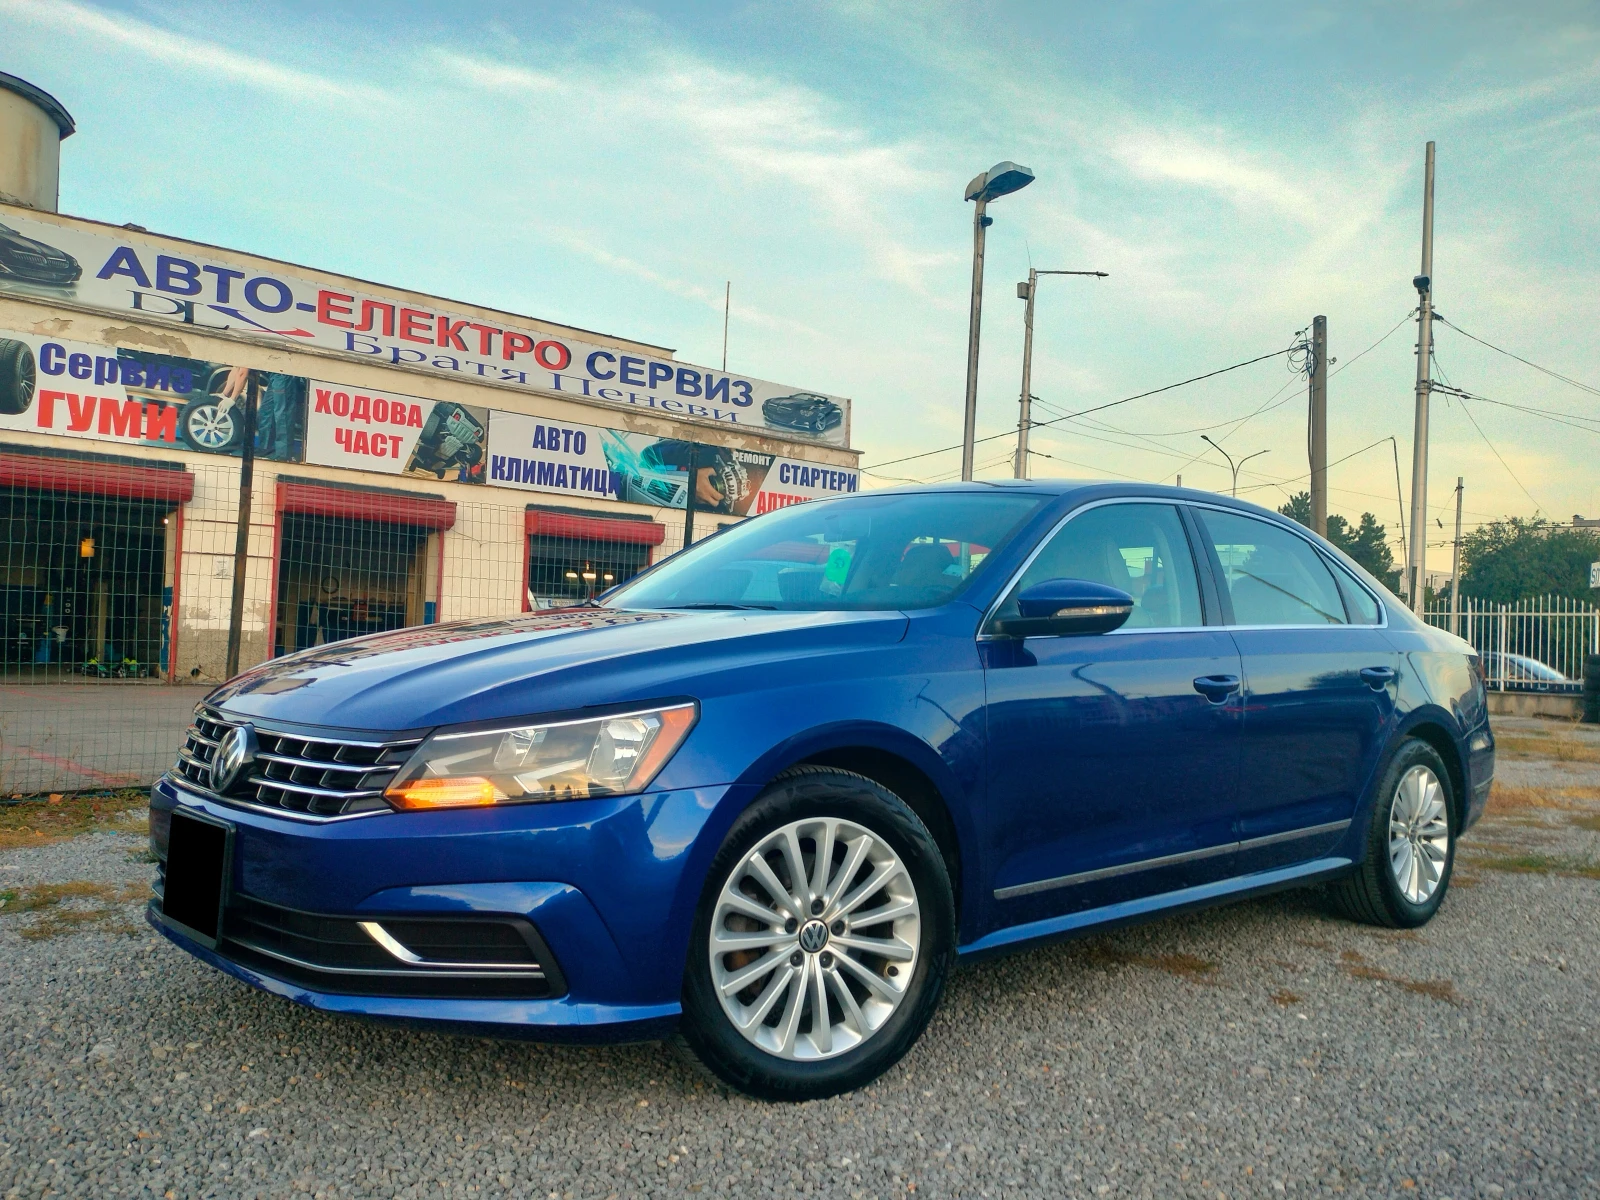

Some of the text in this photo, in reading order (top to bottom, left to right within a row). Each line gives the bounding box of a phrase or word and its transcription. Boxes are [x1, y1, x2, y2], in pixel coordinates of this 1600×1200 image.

[96, 246, 754, 407] АВТО-ЕЛЕКТРО СЕРВИЗ
[39, 342, 193, 394] Сервиз
[339, 330, 740, 424] Братя Пеневи
[37, 389, 178, 443] ГУМИ
[315, 388, 423, 428] ХОДОВА
[334, 427, 403, 459] ЧАСТ
[532, 424, 587, 456] АВТО
[732, 451, 771, 466] РЕМОНТ
[491, 454, 620, 497] КЛИМАТИЦИ
[779, 463, 857, 493] СТАРТЕРИ
